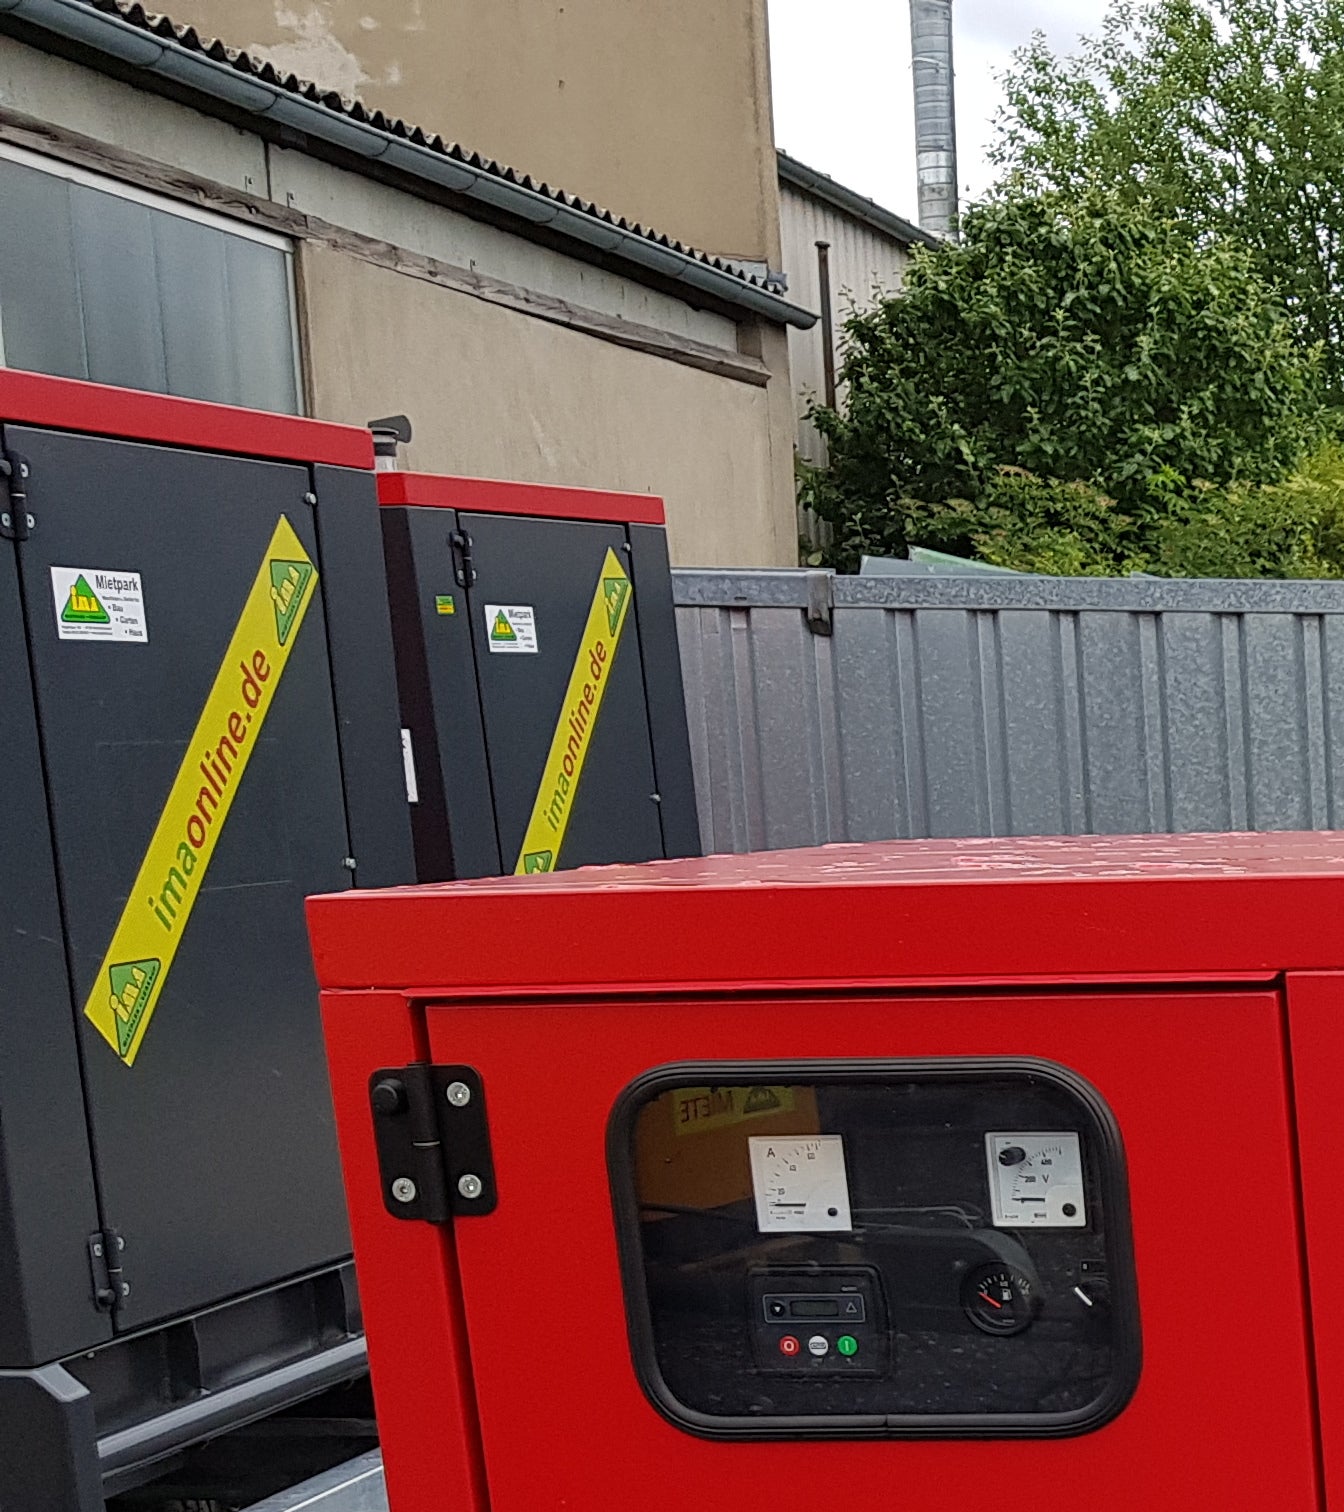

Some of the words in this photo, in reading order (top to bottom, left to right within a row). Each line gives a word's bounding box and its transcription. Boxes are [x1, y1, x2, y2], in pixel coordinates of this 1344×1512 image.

[95, 574, 139, 594] Mietpark
[543, 640, 607, 832] imaonline.de
[148, 649, 271, 932] imaonline.de
[766, 1147, 776, 1158] A
